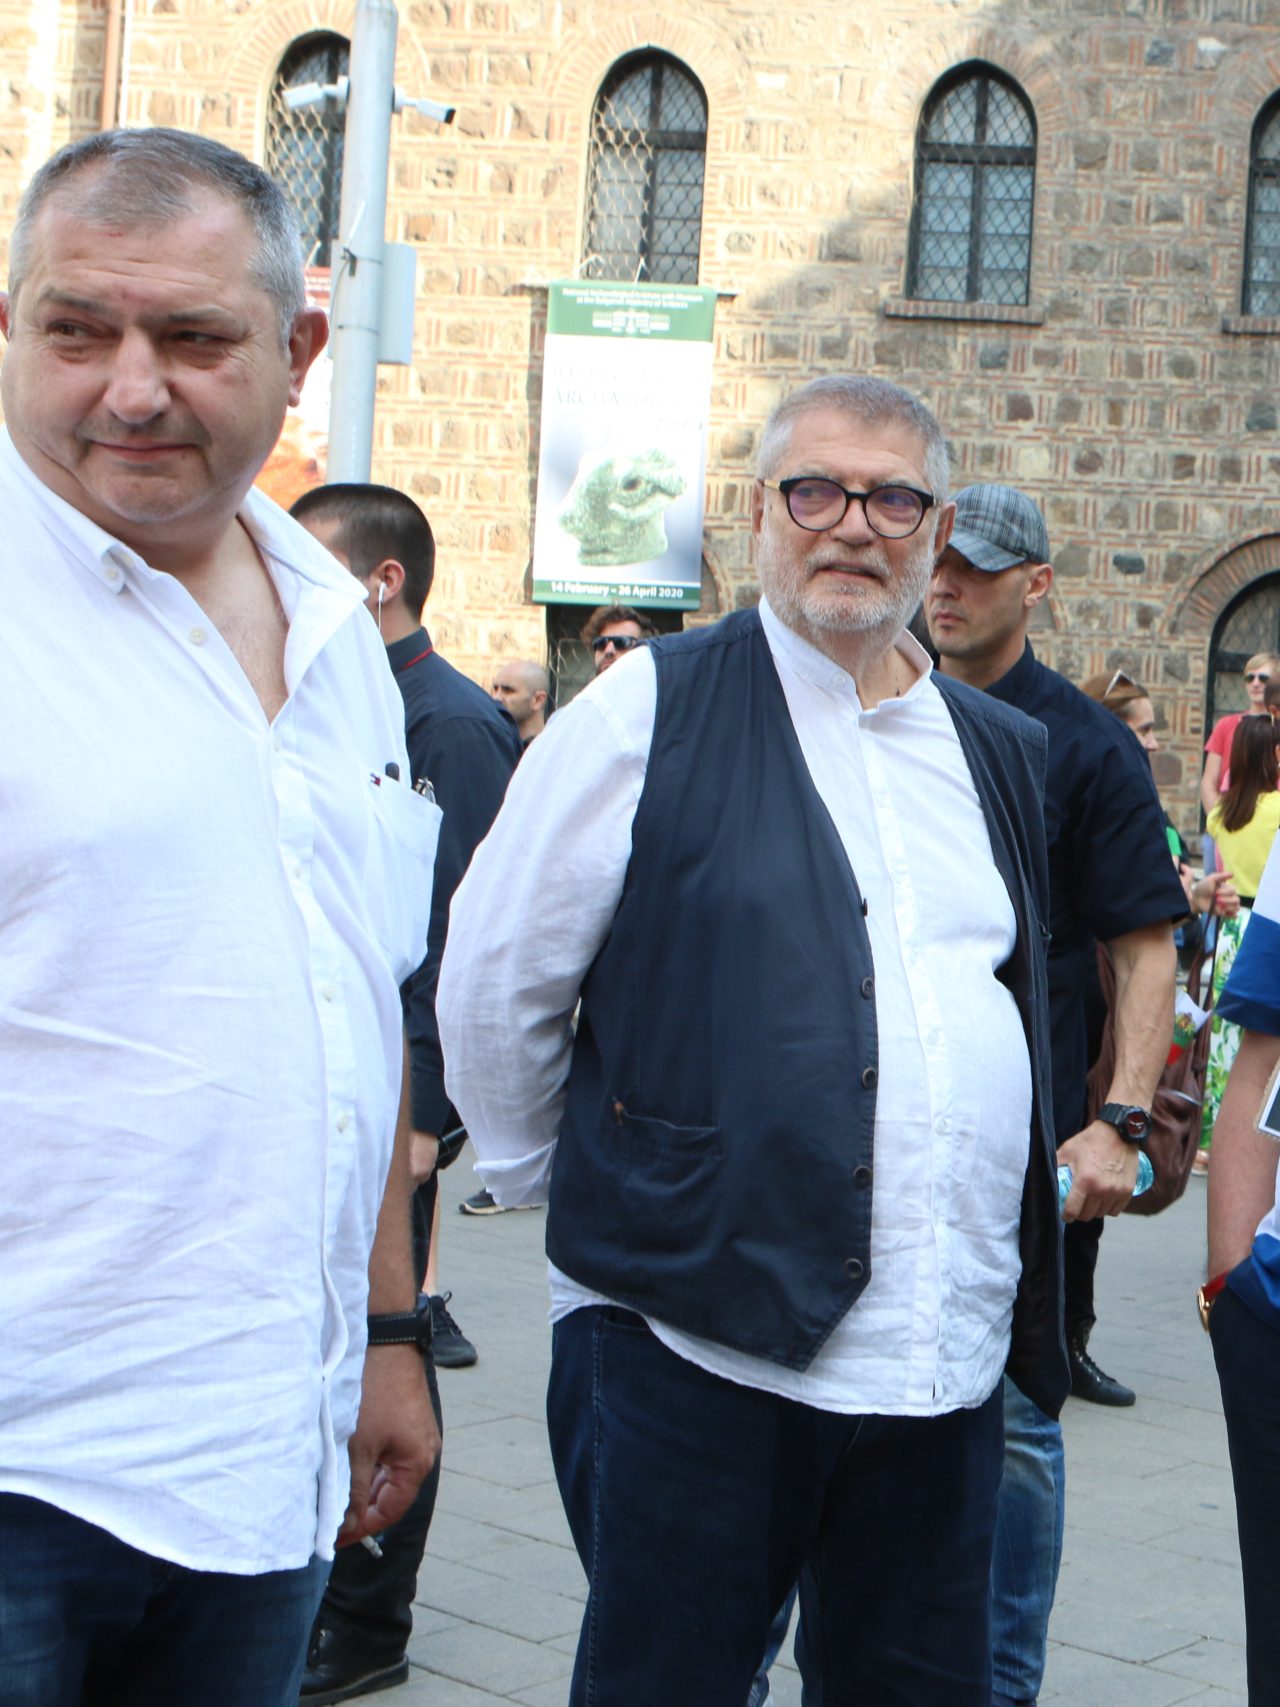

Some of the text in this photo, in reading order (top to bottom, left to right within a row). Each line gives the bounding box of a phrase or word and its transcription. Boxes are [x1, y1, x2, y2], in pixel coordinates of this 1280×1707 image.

[551, 581, 564, 593] 14
[564, 582, 609, 597] February
[618, 585, 631, 596] 26
[632, 585, 657, 598] April
[659, 587, 684, 598] 2020
